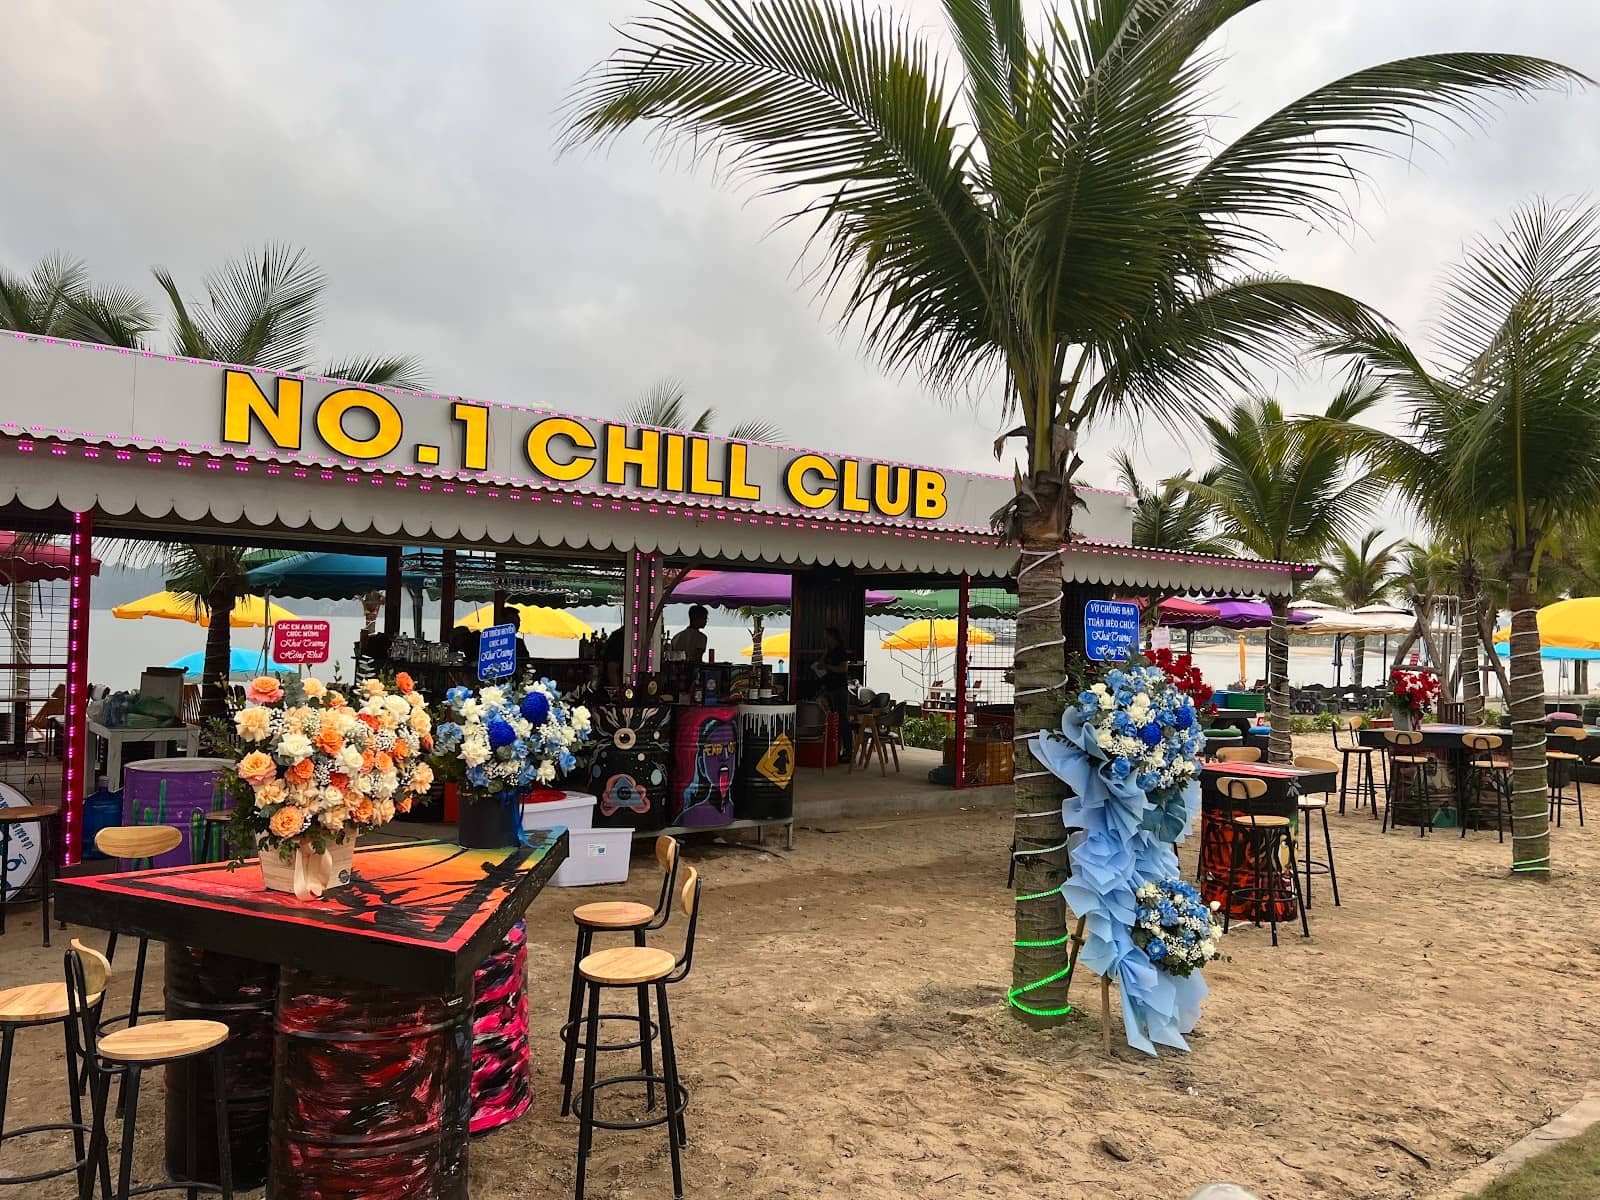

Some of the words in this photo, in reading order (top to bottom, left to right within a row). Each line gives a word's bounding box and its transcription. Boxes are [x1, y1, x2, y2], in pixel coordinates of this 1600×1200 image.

[222, 369, 489, 470] NO.1
[526, 416, 761, 501] CHILL
[784, 455, 949, 519] CLUB
